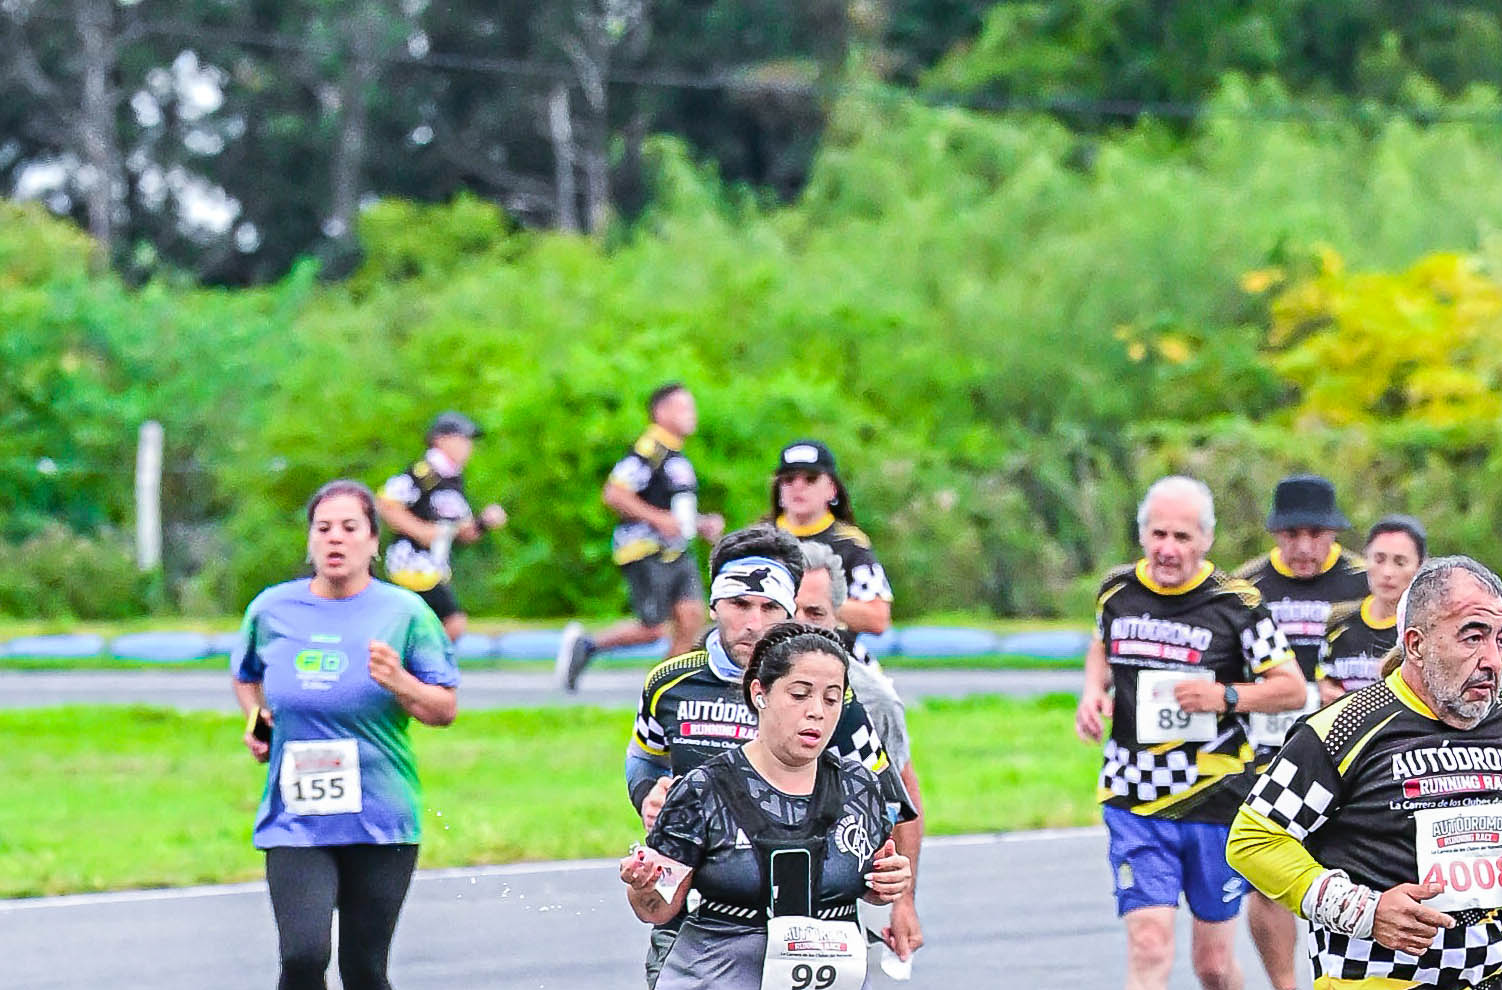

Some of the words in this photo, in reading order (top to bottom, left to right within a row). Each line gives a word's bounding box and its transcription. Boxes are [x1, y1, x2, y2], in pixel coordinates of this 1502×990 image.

[1158, 707, 1192, 730] 89
[292, 777, 345, 802] 155
[1420, 775, 1480, 796] RUNNING
[1403, 800, 1436, 810] Carrera
[1437, 799, 1449, 808] de
[1450, 798, 1461, 807] los
[791, 963, 837, 990] 99
